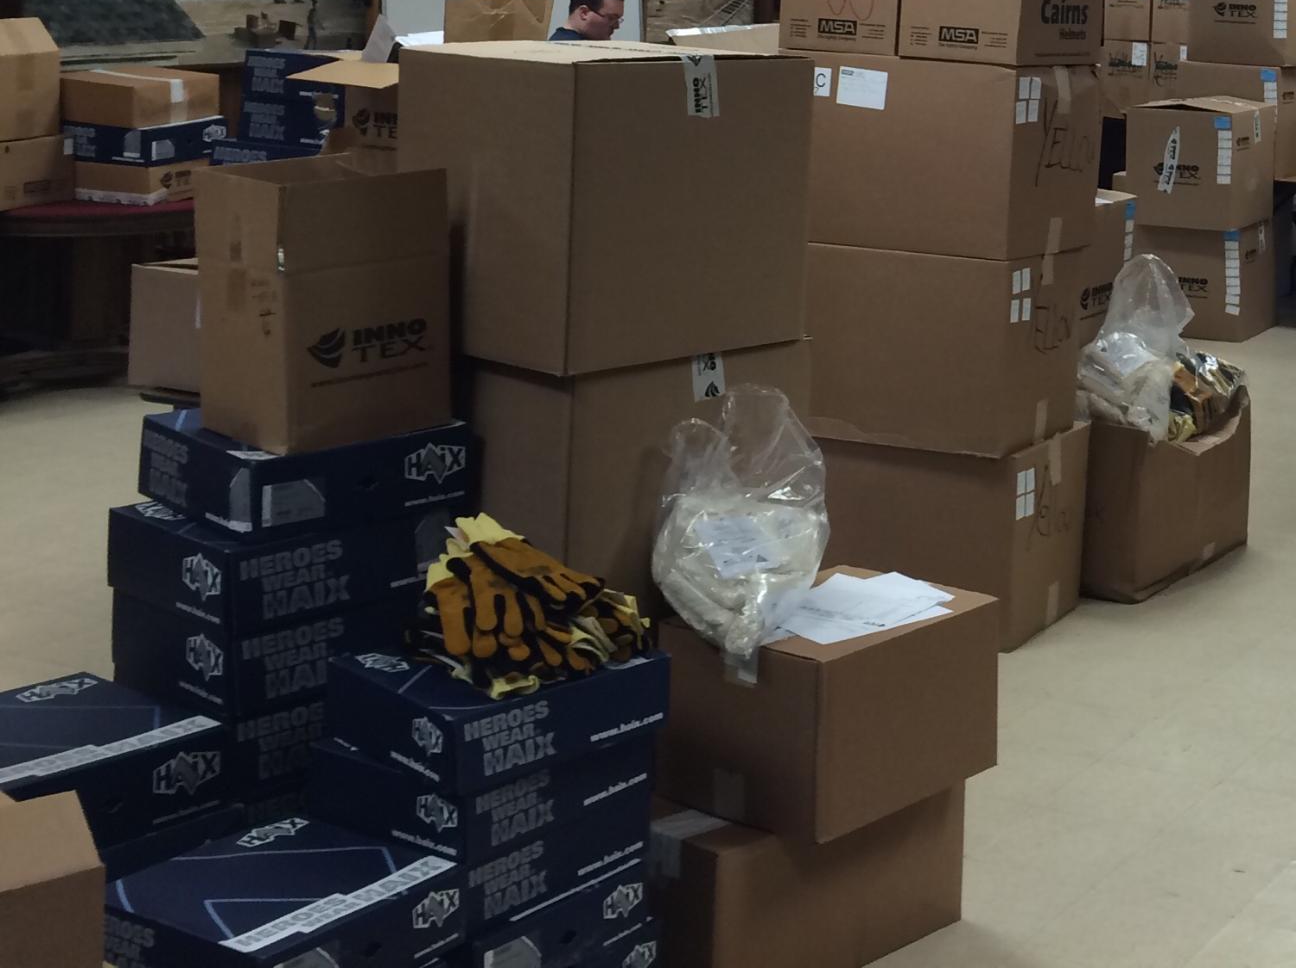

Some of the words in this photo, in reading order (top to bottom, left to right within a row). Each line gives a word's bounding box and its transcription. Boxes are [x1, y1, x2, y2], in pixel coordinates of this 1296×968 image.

[819, 19, 856, 35] MSA
[940, 27, 978, 43] MSA
[351, 317, 428, 346] INNO
[351, 337, 427, 364] TEX
[239, 538, 344, 582] HEROES
[261, 574, 352, 621] HAIX
[240, 616, 345, 661] HEROES
[463, 699, 551, 743] HEROES
[482, 732, 558, 778] HAIX
[475, 769, 551, 816] HEROES
[490, 799, 556, 848] HAIX
[468, 839, 545, 889] HEROES
[483, 870, 549, 921] HAIX
